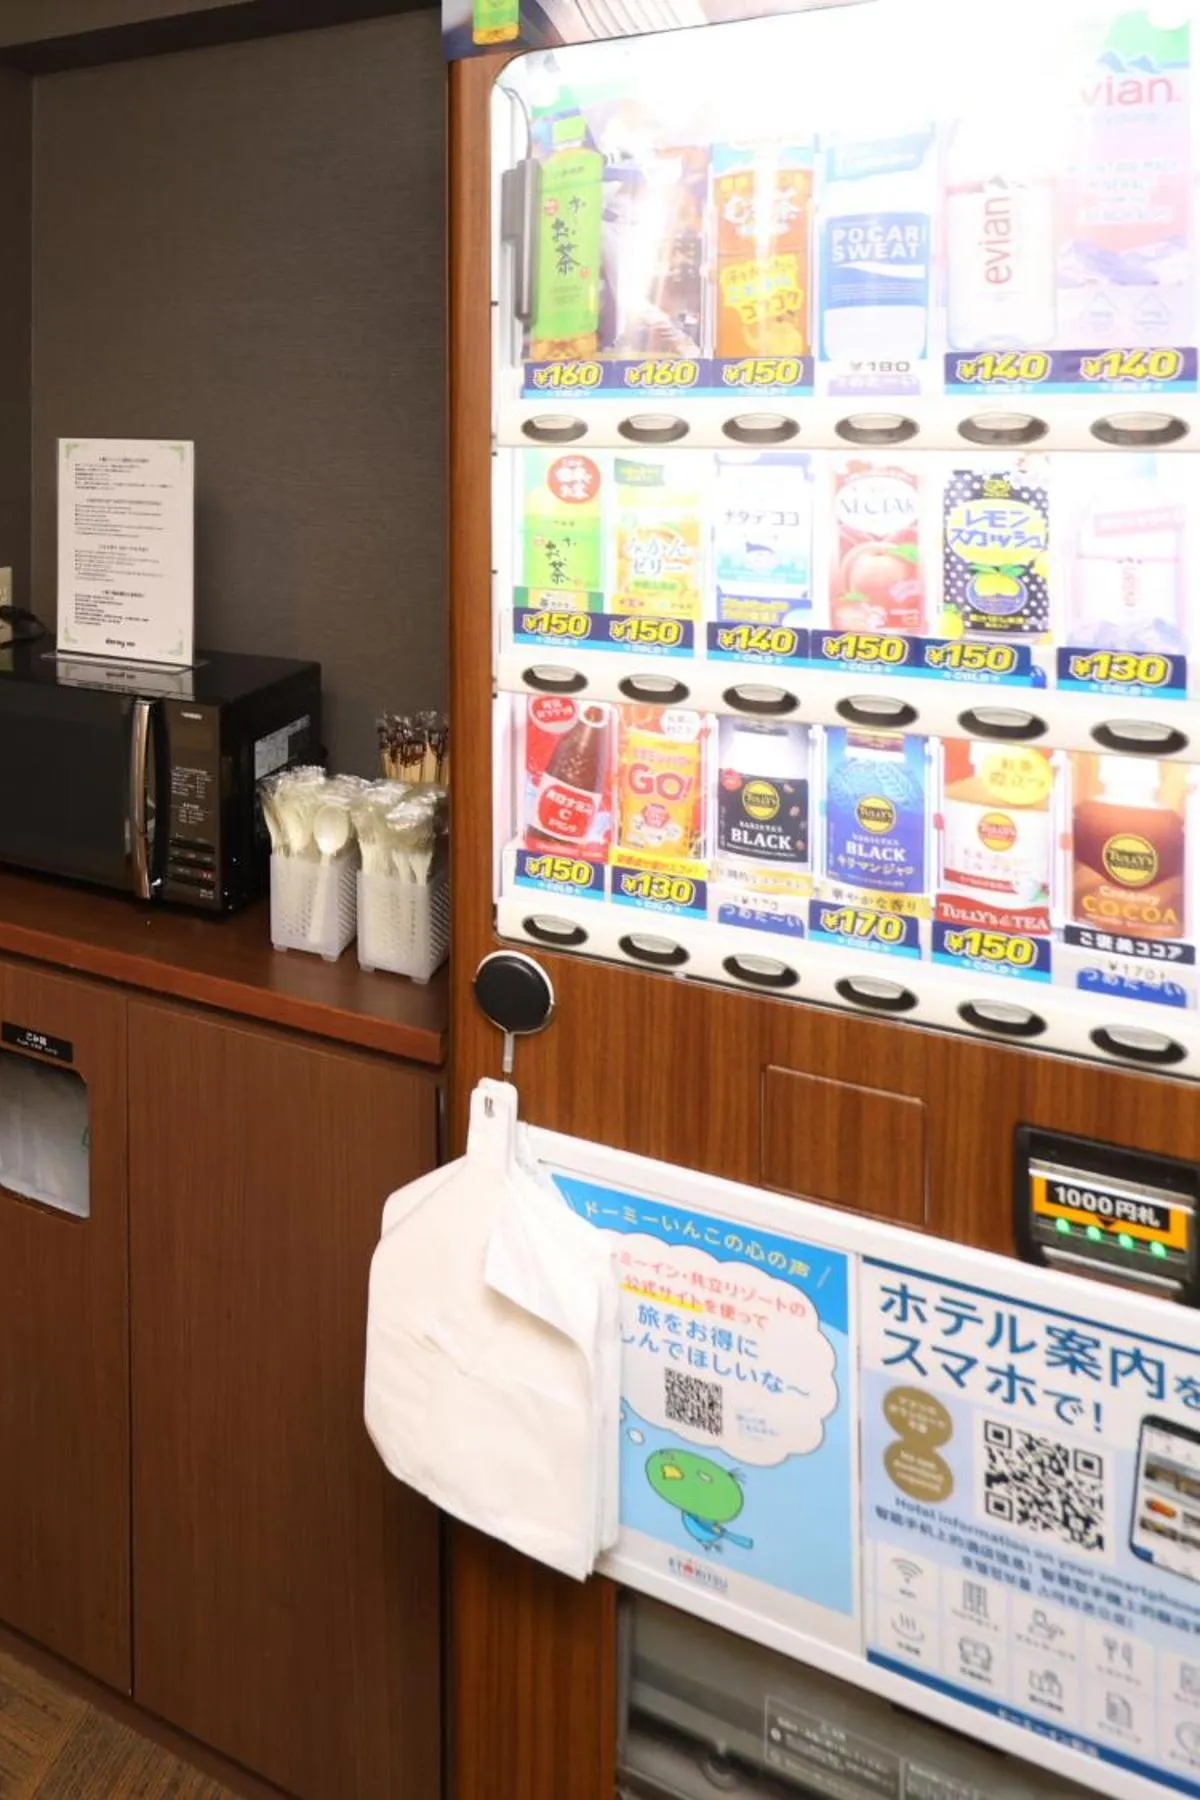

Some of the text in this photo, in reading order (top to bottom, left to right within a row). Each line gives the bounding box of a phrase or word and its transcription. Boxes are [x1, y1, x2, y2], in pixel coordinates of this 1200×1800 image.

[831, 224, 927, 244] POCARI
[978, 196, 1012, 285] evian
[831, 242, 921, 263] SWEAT
[536, 363, 600, 387] ¥160
[628, 361, 696, 387] ¥160
[726, 359, 799, 385] ¥150
[959, 353, 1048, 380] ¥140
[1084, 350, 1178, 378] ¥140
[965, 508, 1032, 529] レモン
[950, 528, 1045, 549] スカッシュ
[525, 612, 591, 638] ¥150
[612, 618, 682, 644] ¥150
[721, 626, 797, 654] ¥140
[825, 633, 906, 662] ¥150
[929, 643, 1015, 671] ¥150
[1074, 652, 1169, 685] ¥130
[628, 762, 694, 801] GO!
[730, 827, 793, 850] BLACK
[846, 841, 907, 862] BLACK
[529, 857, 592, 886] ¥150
[624, 873, 693, 904] ¥130
[938, 902, 998, 925] TULLY'S
[1081, 895, 1178, 924] COCOA
[825, 908, 904, 941] ¥170
[948, 930, 1035, 966] ¥150
[1054, 1184, 1161, 1228] 1000円札
[584, 1200, 812, 1279] ドーミーいんこの心の声
[612, 1250, 807, 1318] ミーイン・共立リゾートの
[624, 1272, 770, 1330] 公式サイトを使って
[638, 1303, 760, 1359] 旅をお得に
[620, 1323, 810, 1397] しんでほしいな〜
[881, 1328, 1103, 1432] スマホで!
